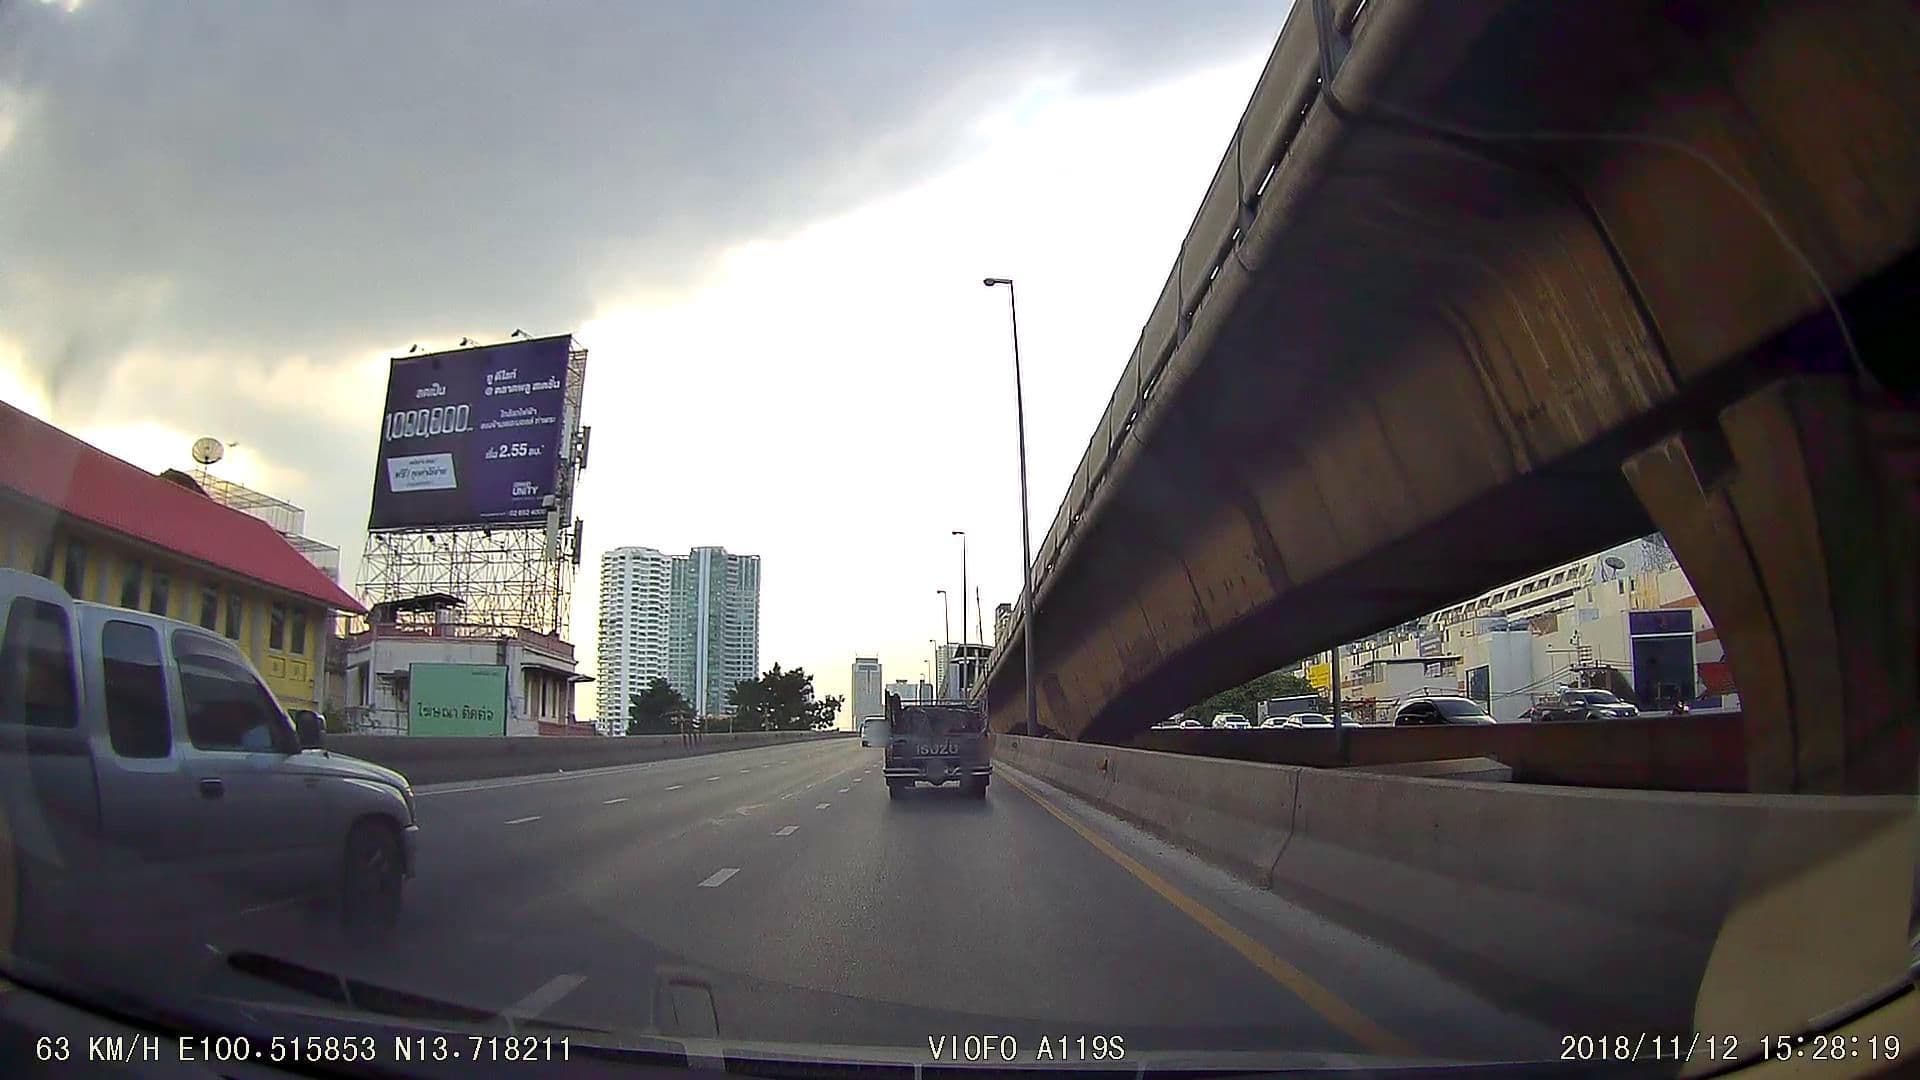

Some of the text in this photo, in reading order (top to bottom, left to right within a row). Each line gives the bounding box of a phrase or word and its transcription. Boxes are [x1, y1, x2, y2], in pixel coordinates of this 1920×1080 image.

[499, 443, 528, 459] 2.55
[512, 487, 539, 496] UNITY
[461, 703, 494, 721] ติดต่อ
[915, 742, 959, 756] ISUZU
